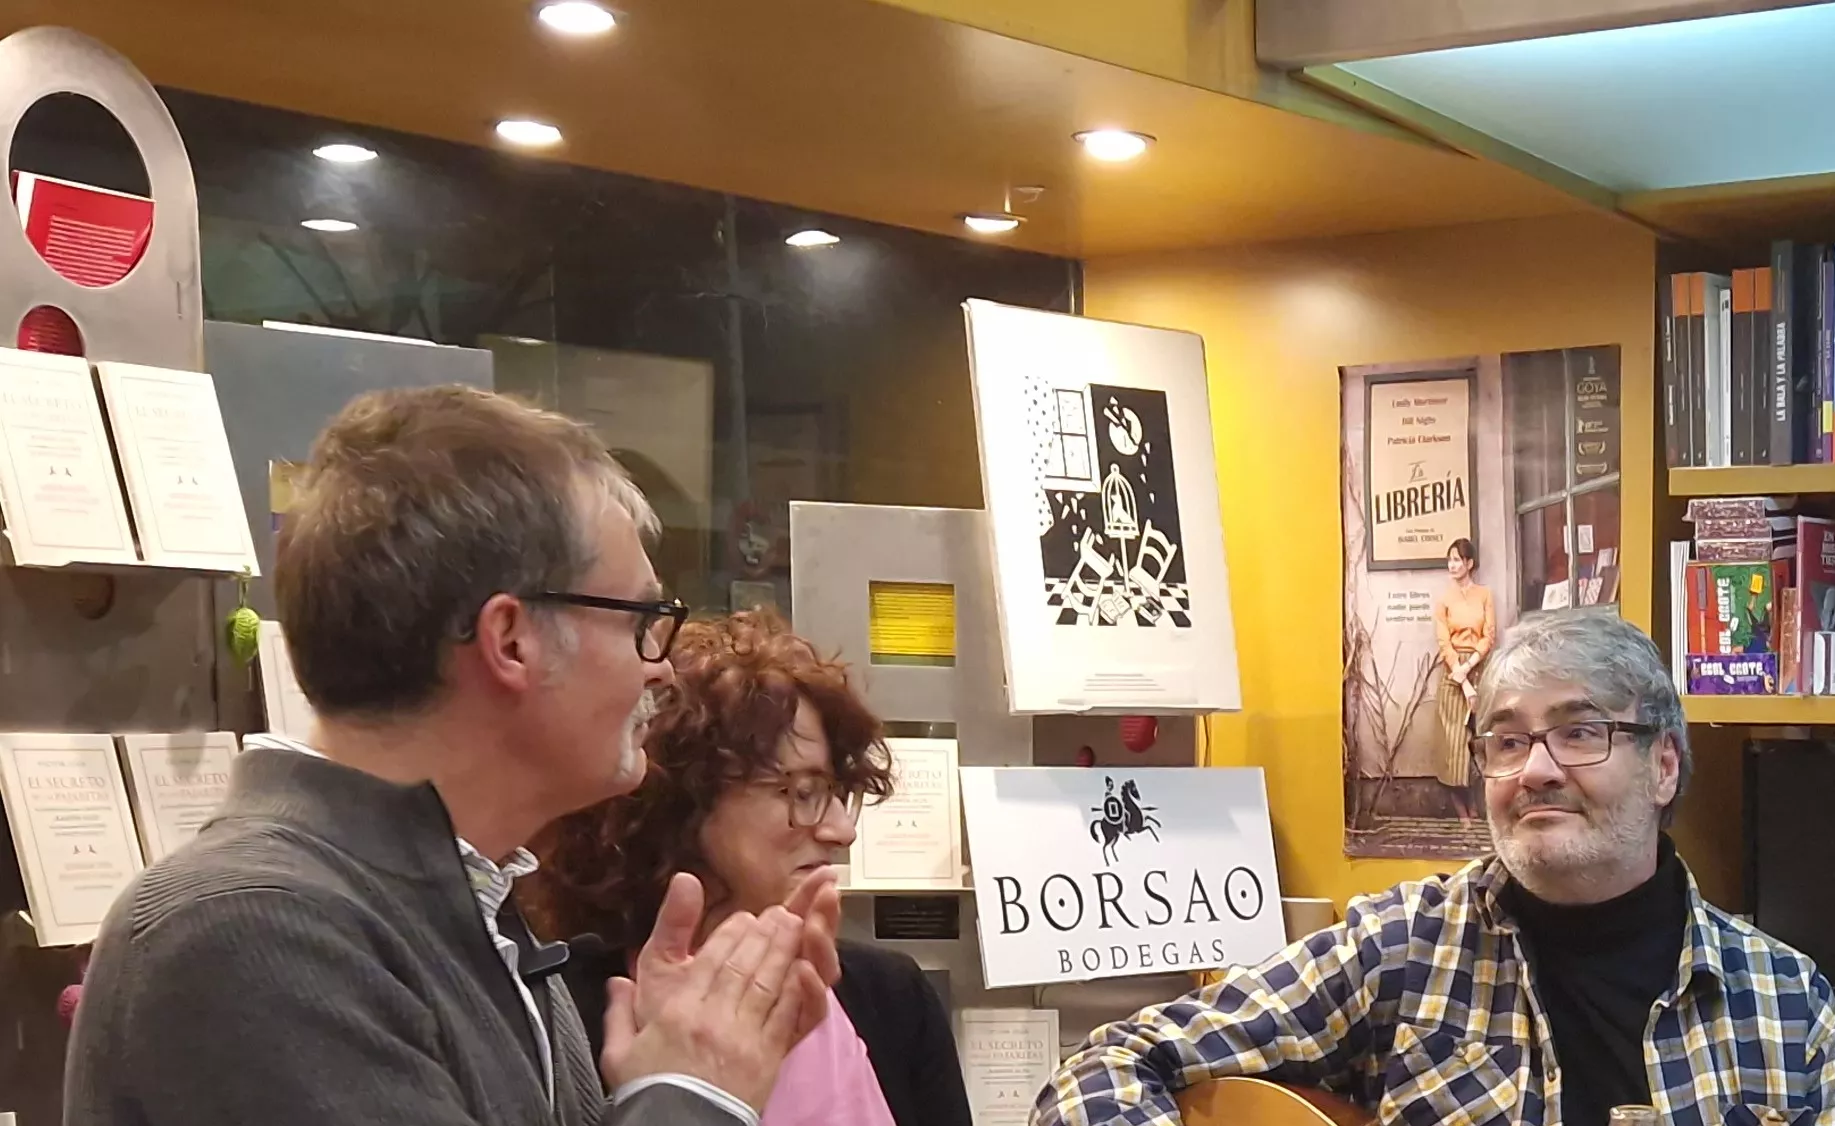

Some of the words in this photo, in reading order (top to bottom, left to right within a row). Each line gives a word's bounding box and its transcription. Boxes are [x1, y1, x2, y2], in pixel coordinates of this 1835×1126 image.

[1776, 410, 1785, 421] LA
[1375, 470, 1465, 524] LIBRERÍA
[992, 866, 1263, 934] BORSAO
[1058, 939, 1225, 974] BODEGAS
